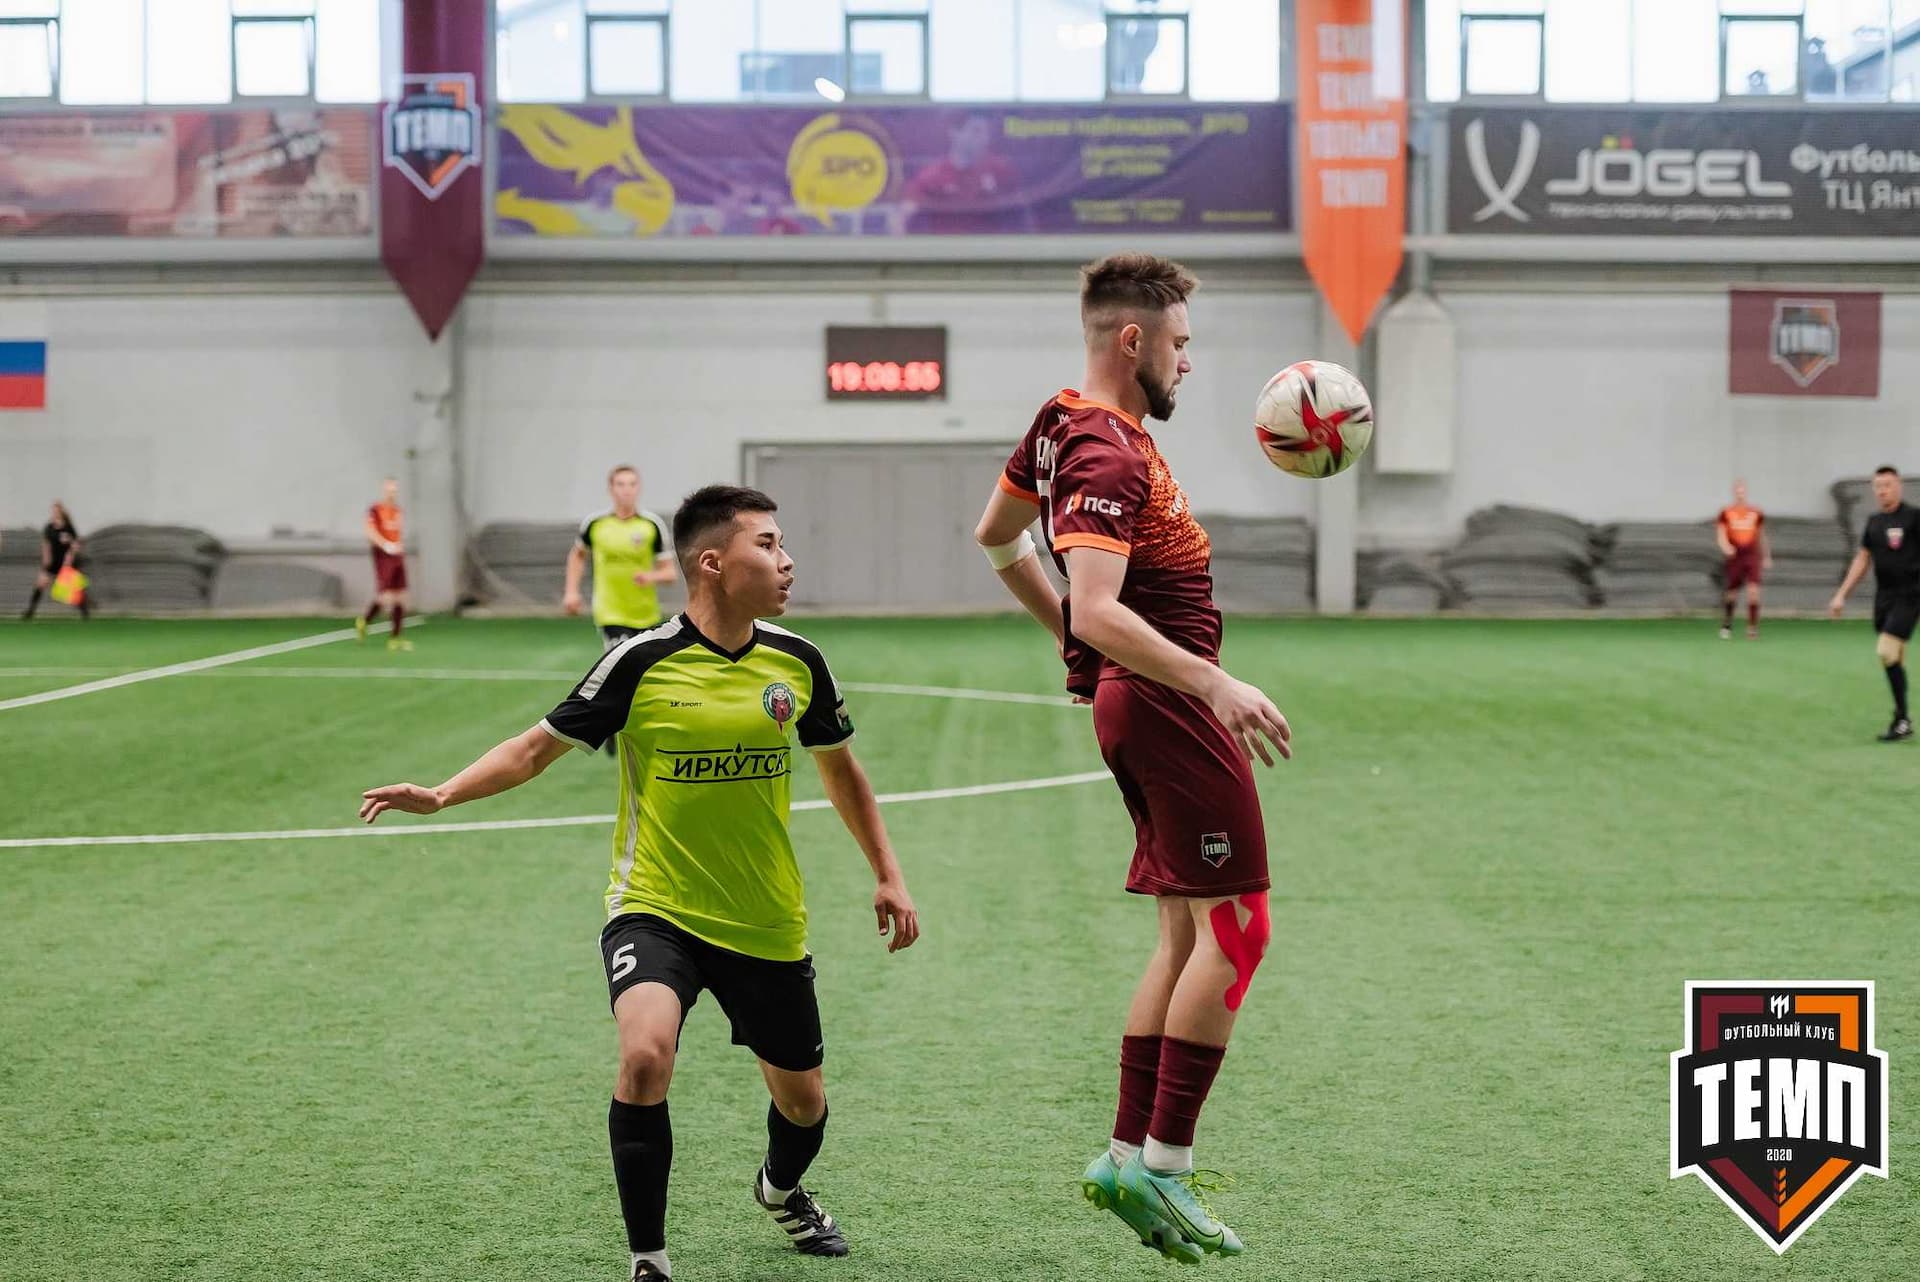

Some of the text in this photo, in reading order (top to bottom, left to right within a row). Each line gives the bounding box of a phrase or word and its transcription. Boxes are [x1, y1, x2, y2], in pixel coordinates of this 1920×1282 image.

[1822, 179, 1865, 214] ТЦ
[1083, 496, 1122, 516] ПСБ
[673, 752, 789, 778] ИРКУТСК
[1205, 842, 1228, 856] ТЕМП
[612, 943, 637, 983] 5
